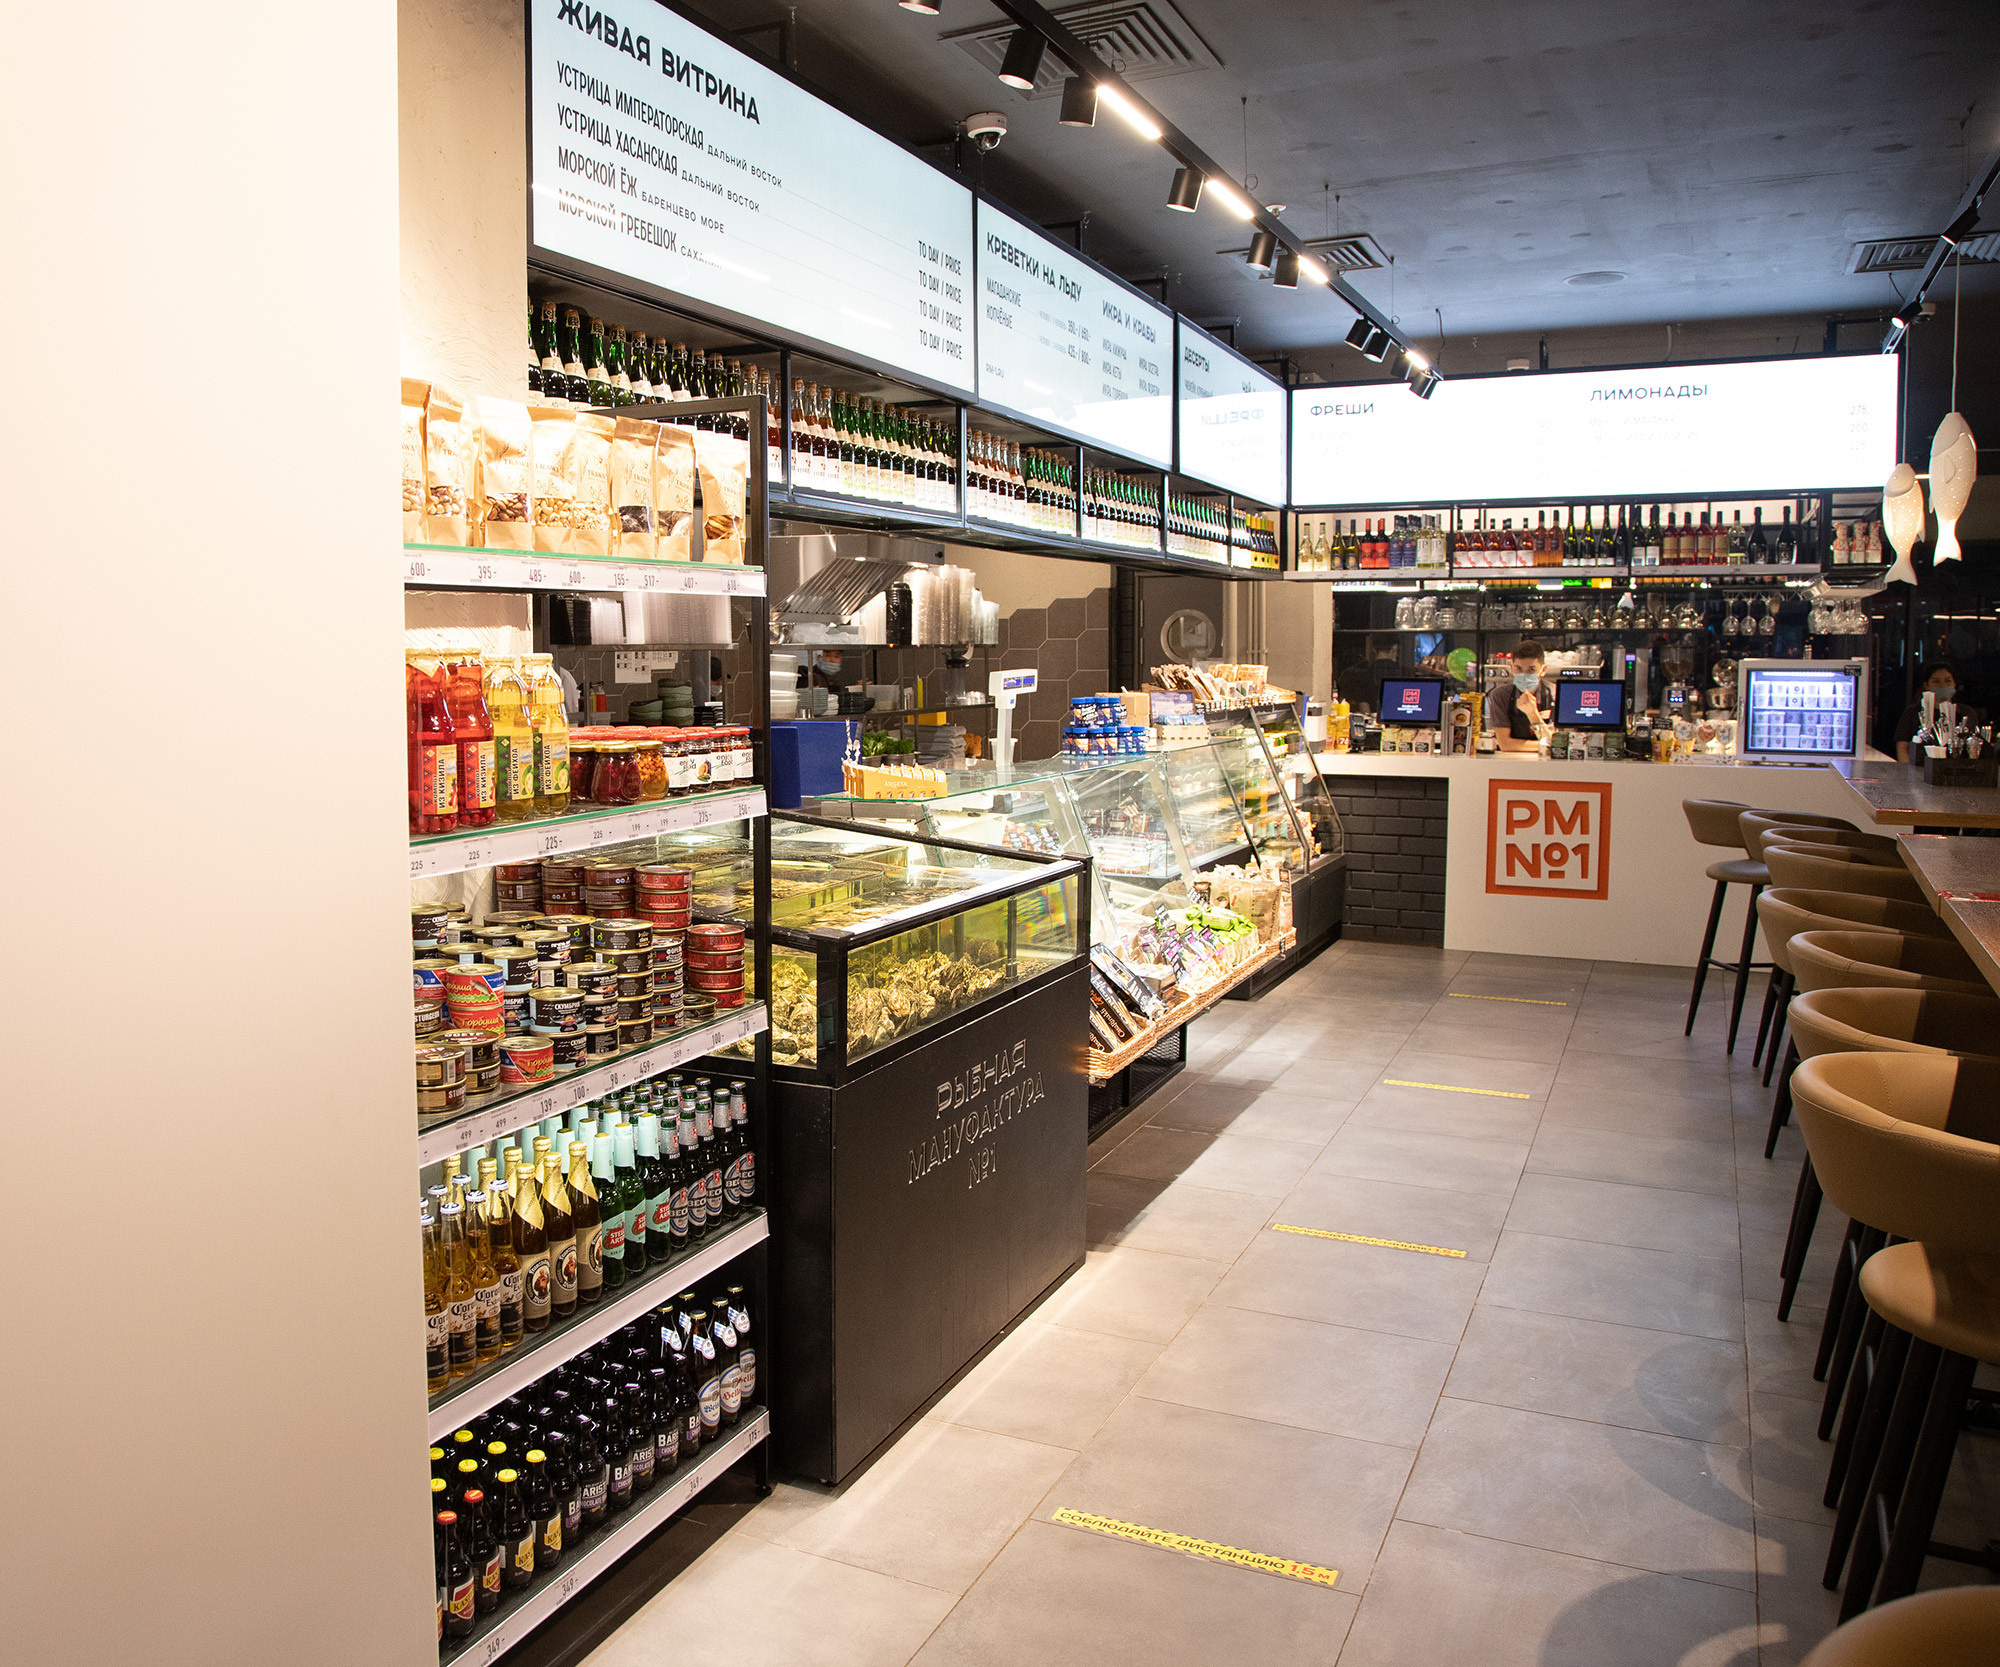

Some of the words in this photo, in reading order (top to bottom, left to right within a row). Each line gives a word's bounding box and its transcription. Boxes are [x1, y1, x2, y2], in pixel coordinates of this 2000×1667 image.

[557, 0, 650, 67] ЖИВАЯ
[662, 47, 760, 125] ВИТРИНА
[557, 60, 611, 107] УСТРИЦА
[615, 89, 704, 151] ИМПЕРАТОРСКАЯ
[707, 144, 748, 171] ДАЛЬНИЙ
[751, 165, 783, 188] ВОСТОК
[557, 103, 612, 147] УСТРИЦА
[616, 129, 678, 176] ХАСАНСКАЯ
[681, 169, 724, 196] ДАЛЬНИЙ
[727, 190, 760, 212] ВОСТОК
[558, 146, 616, 190] МОРСКОЙ
[620, 167, 637, 198] ЁЖ
[641, 190, 697, 222] БАРЕНЦЕВО
[700, 214, 725, 234] МОРЕ
[620, 212, 677, 252] ГРЕБЕШОК
[918, 240, 927, 257] TO
[928, 244, 939, 263] DAY
[945, 255, 961, 276] PRICE
[987, 232, 1040, 279] КРЕВЕТКИ
[1042, 264, 1056, 289] НА
[1058, 274, 1082, 302] ЛЬДУ
[918, 270, 927, 287] TO
[928, 274, 939, 293] DAY
[945, 283, 961, 304] PRICE
[918, 300, 927, 317] TO
[929, 304, 940, 323] DAY
[946, 312, 962, 333] PRICE
[1102, 299, 1123, 327] ИКРА
[1132, 316, 1156, 344] КРАБЫ
[919, 329, 928, 347] TO
[929, 333, 940, 351] DAY
[946, 339, 962, 360] PRICE
[1310, 403, 1374, 417] ФРЕШИ
[1590, 384, 1708, 401] ЛИМОНАДЫ
[438, 758, 446, 795] КИЗИЛА
[512, 785, 520, 795] ИЗ
[545, 782, 552, 790] ИЗ
[439, 797, 446, 809] ИЗ
[481, 791, 487, 802] ИЗ
[937, 1038, 1027, 1119] РЫБНАЯ
[908, 1072, 1045, 1185] МАНУФАКТУРА
[969, 1141, 997, 1189] №1
[1060, 1511, 1173, 1544] СОБЛЮДАЙТЕ
[1177, 1539, 1286, 1569] ДИСТАНЦИЮ
